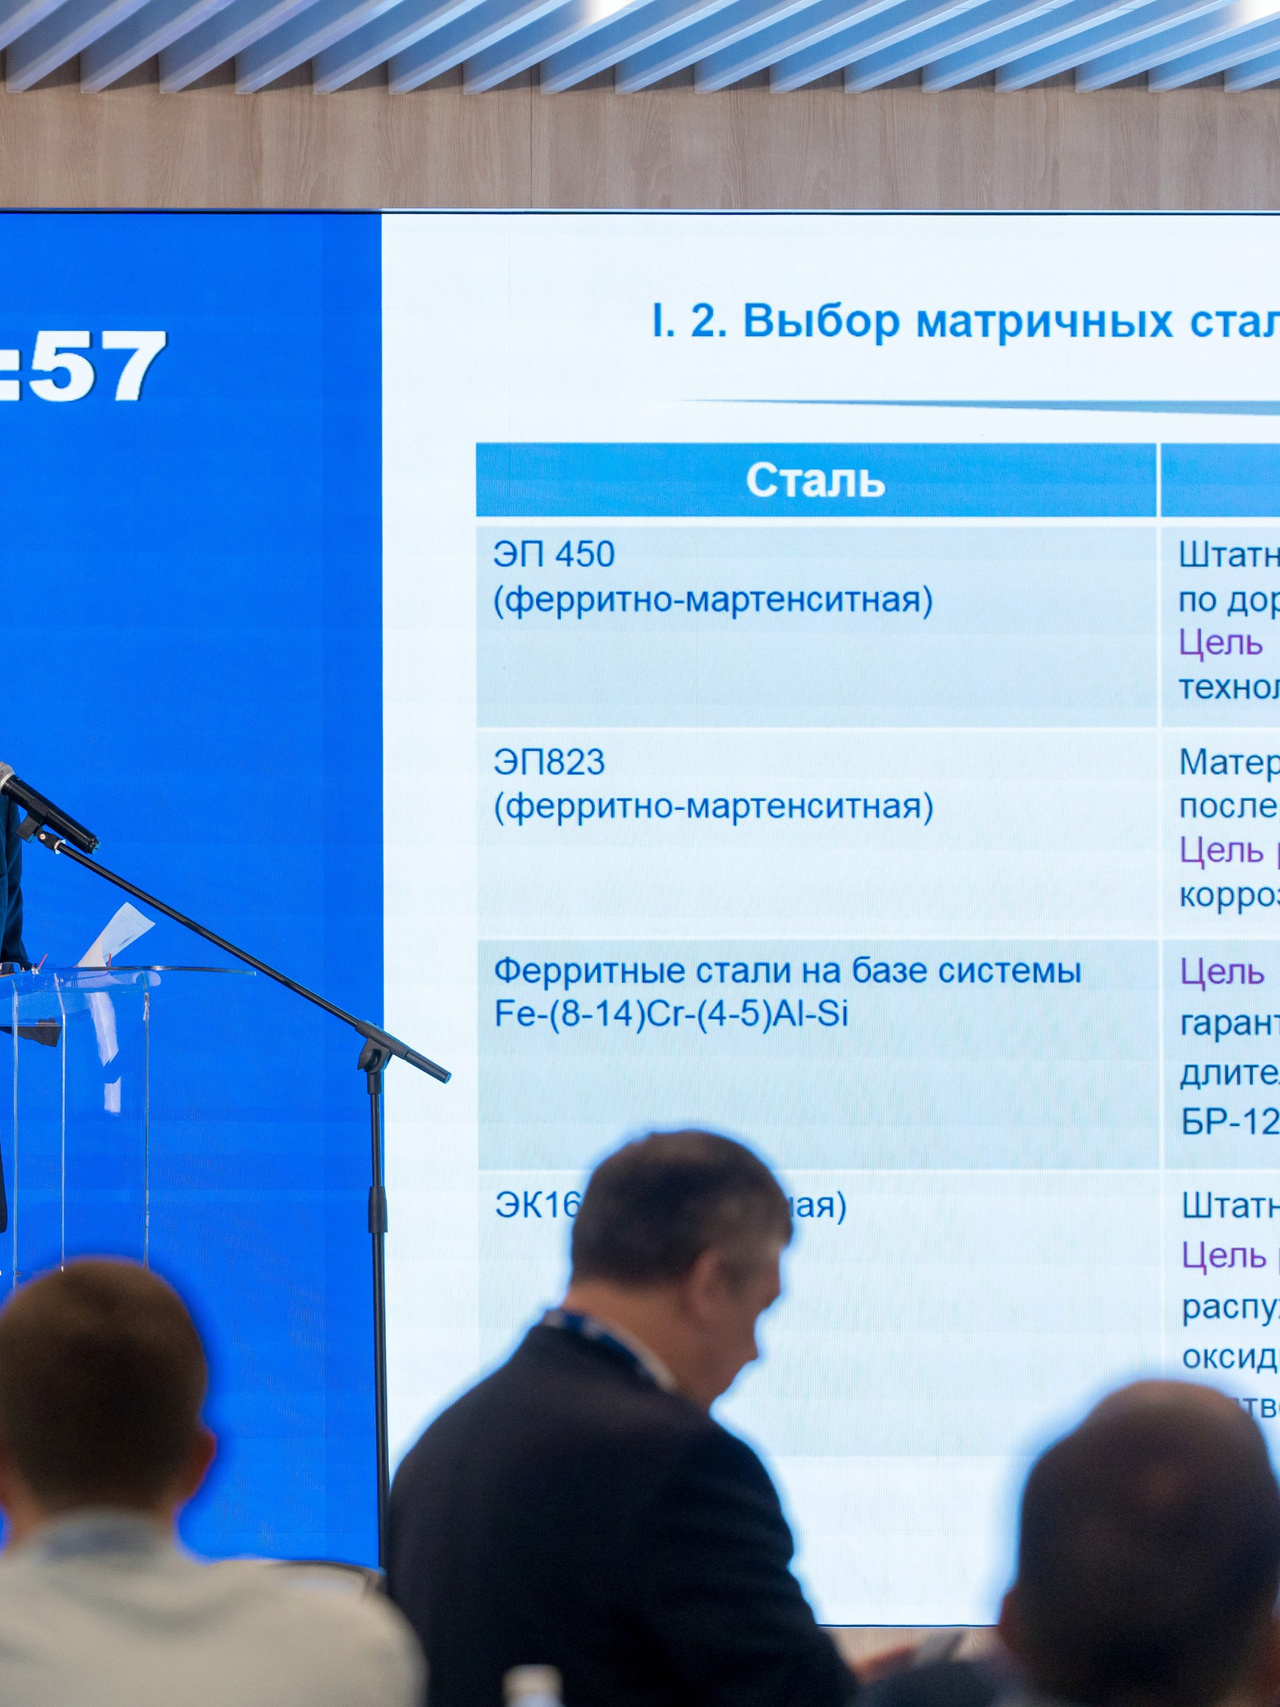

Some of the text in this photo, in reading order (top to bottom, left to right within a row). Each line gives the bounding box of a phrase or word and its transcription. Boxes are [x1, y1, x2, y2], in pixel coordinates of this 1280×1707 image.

[691, 302, 727, 338] 2.
[744, 301, 901, 347] Выбор
[917, 310, 1174, 347] матричных
[746, 461, 886, 498] Сталь
[493, 539, 616, 568] ЭП 450
[1180, 539, 1280, 568] Штатн
[494, 584, 933, 621] (ферритно-мартенситная)
[1179, 590, 1217, 613] по
[1179, 627, 1264, 663] Цель
[494, 747, 606, 776] ЭП823
[1180, 747, 1280, 783] Матер
[494, 790, 934, 827] (ферритно-мартенситная)
[1180, 835, 1265, 871] Цель
[1180, 886, 1280, 916] корро
[494, 955, 1082, 991] Ферритные стали на базе системы
[1181, 956, 1266, 992] Цель
[495, 998, 848, 1035] Fe-(8-14)Cr-(4-5)Al-Si
[1180, 1063, 1280, 1091] длите
[1183, 1240, 1267, 1276] Цель
[1183, 1298, 1280, 1328] распу
